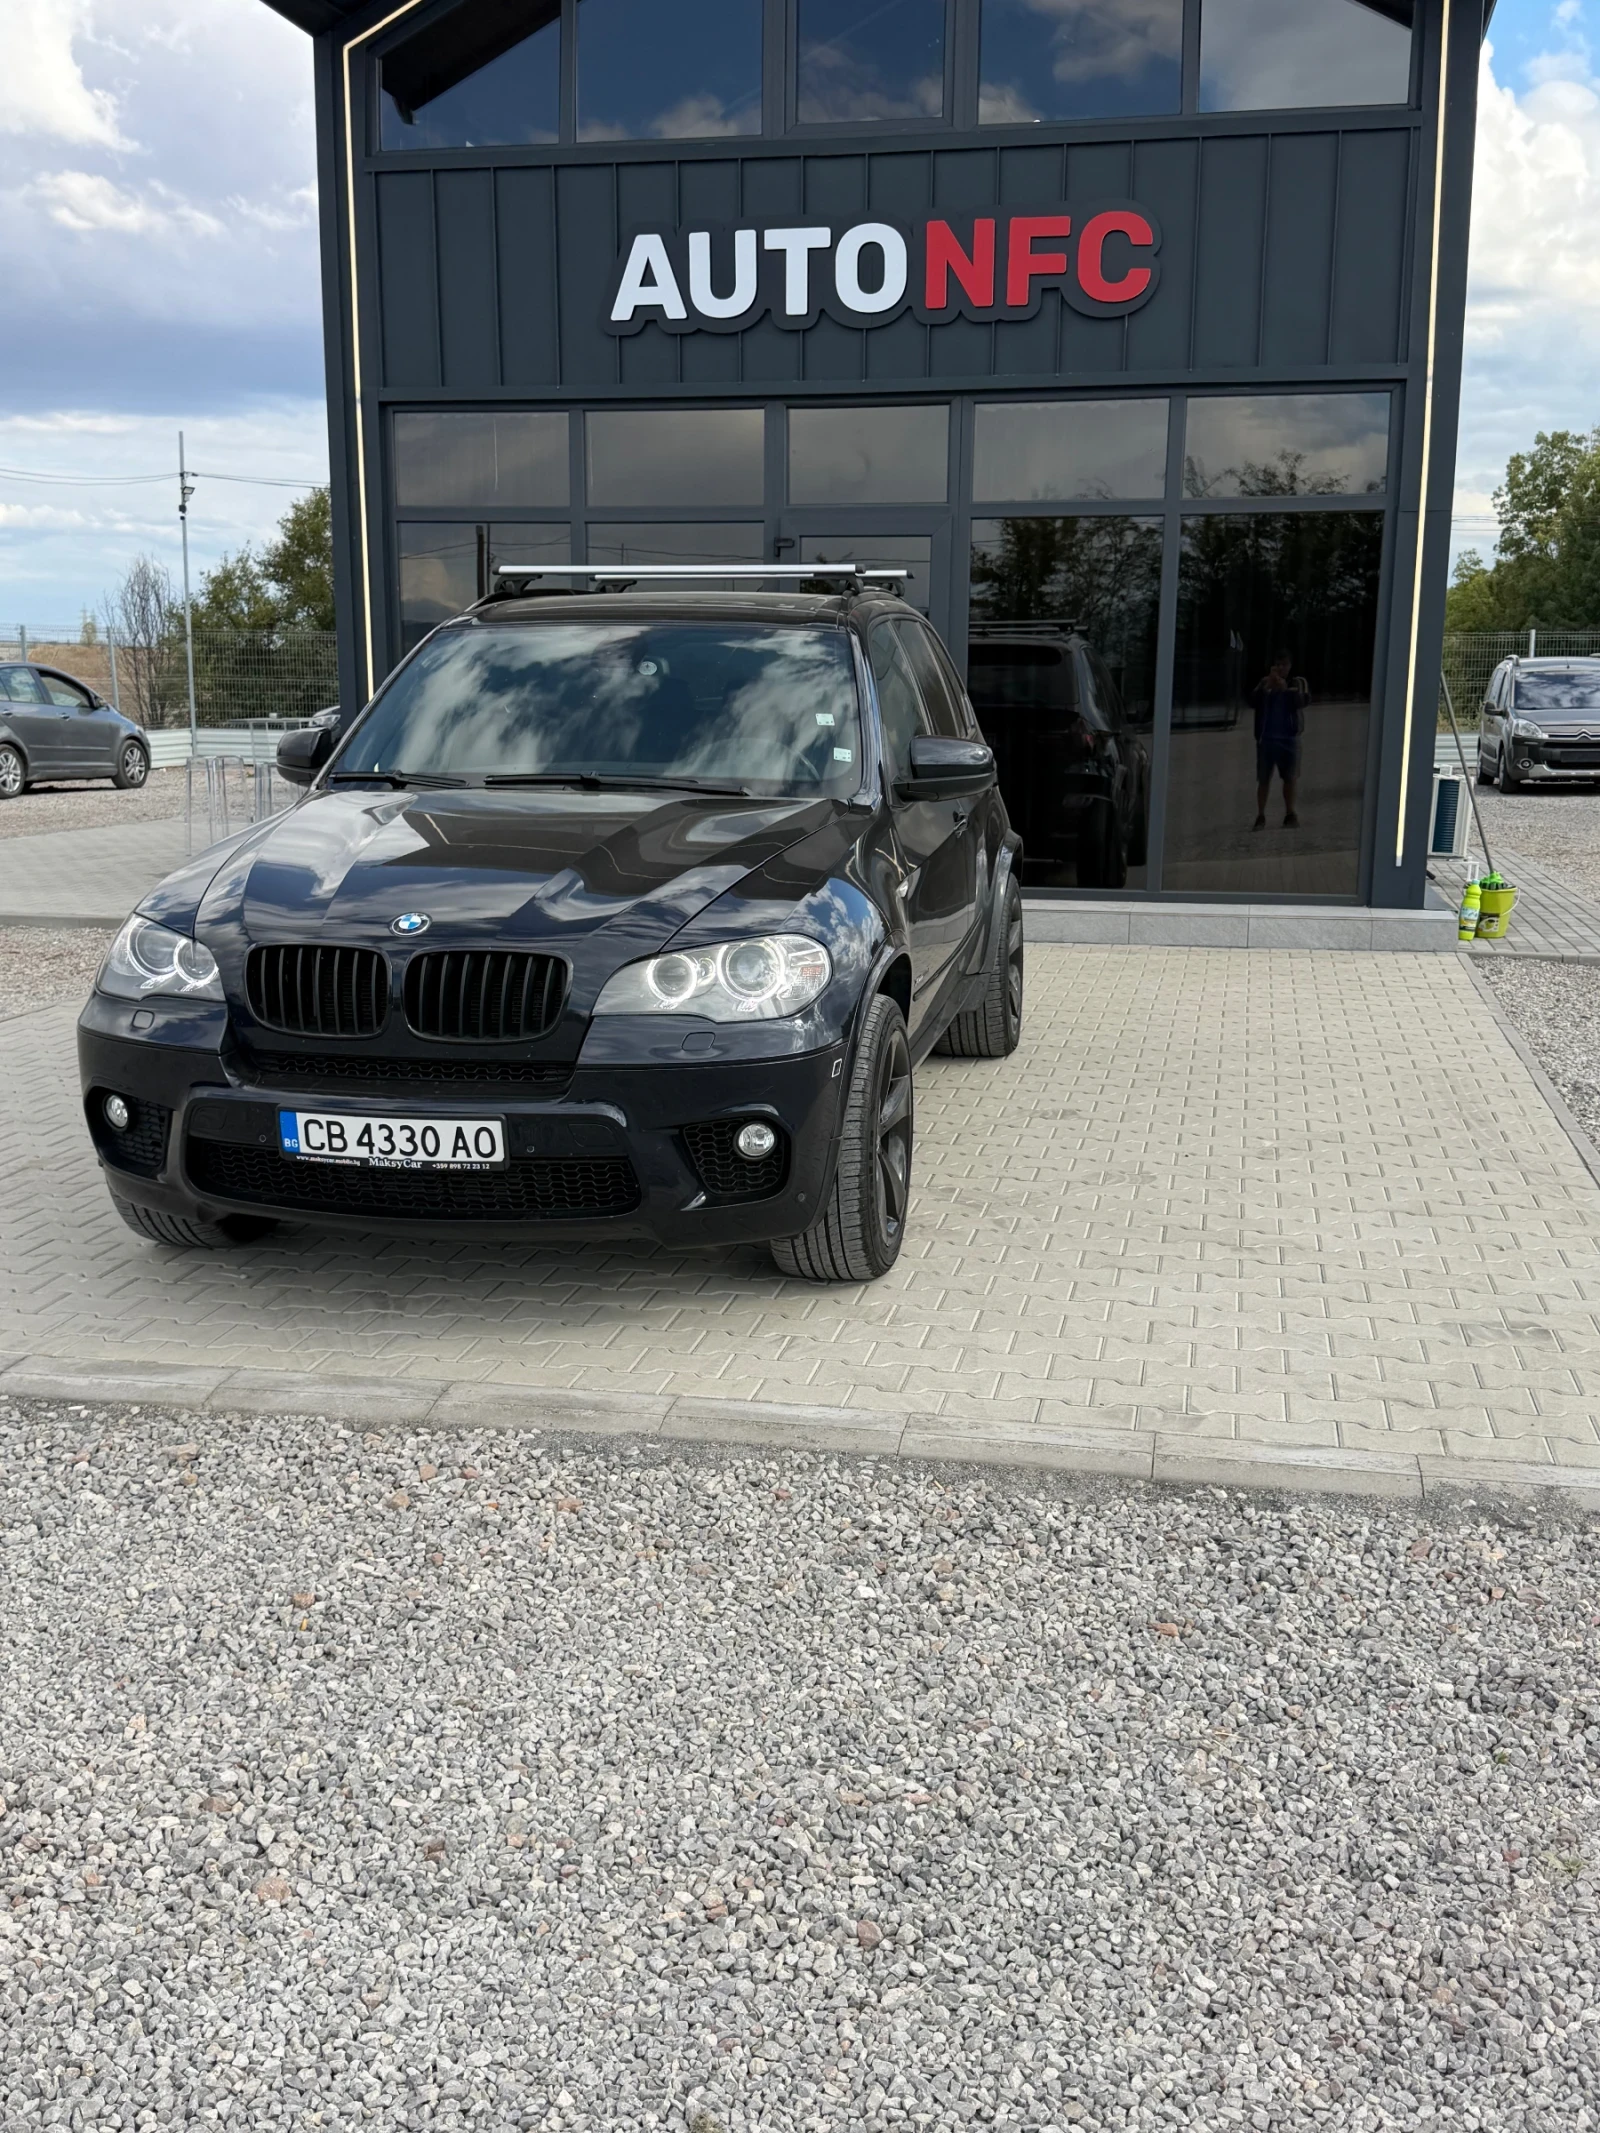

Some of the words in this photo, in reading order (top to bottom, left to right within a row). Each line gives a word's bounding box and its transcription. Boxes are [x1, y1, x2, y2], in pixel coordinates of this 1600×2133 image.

[284, 1138, 299, 1148] BG
[304, 1119, 348, 1153] CB
[356, 1123, 441, 1158] 4330
[451, 1126, 496, 1158] AO
[368, 1157, 422, 1169] MaksyCar
